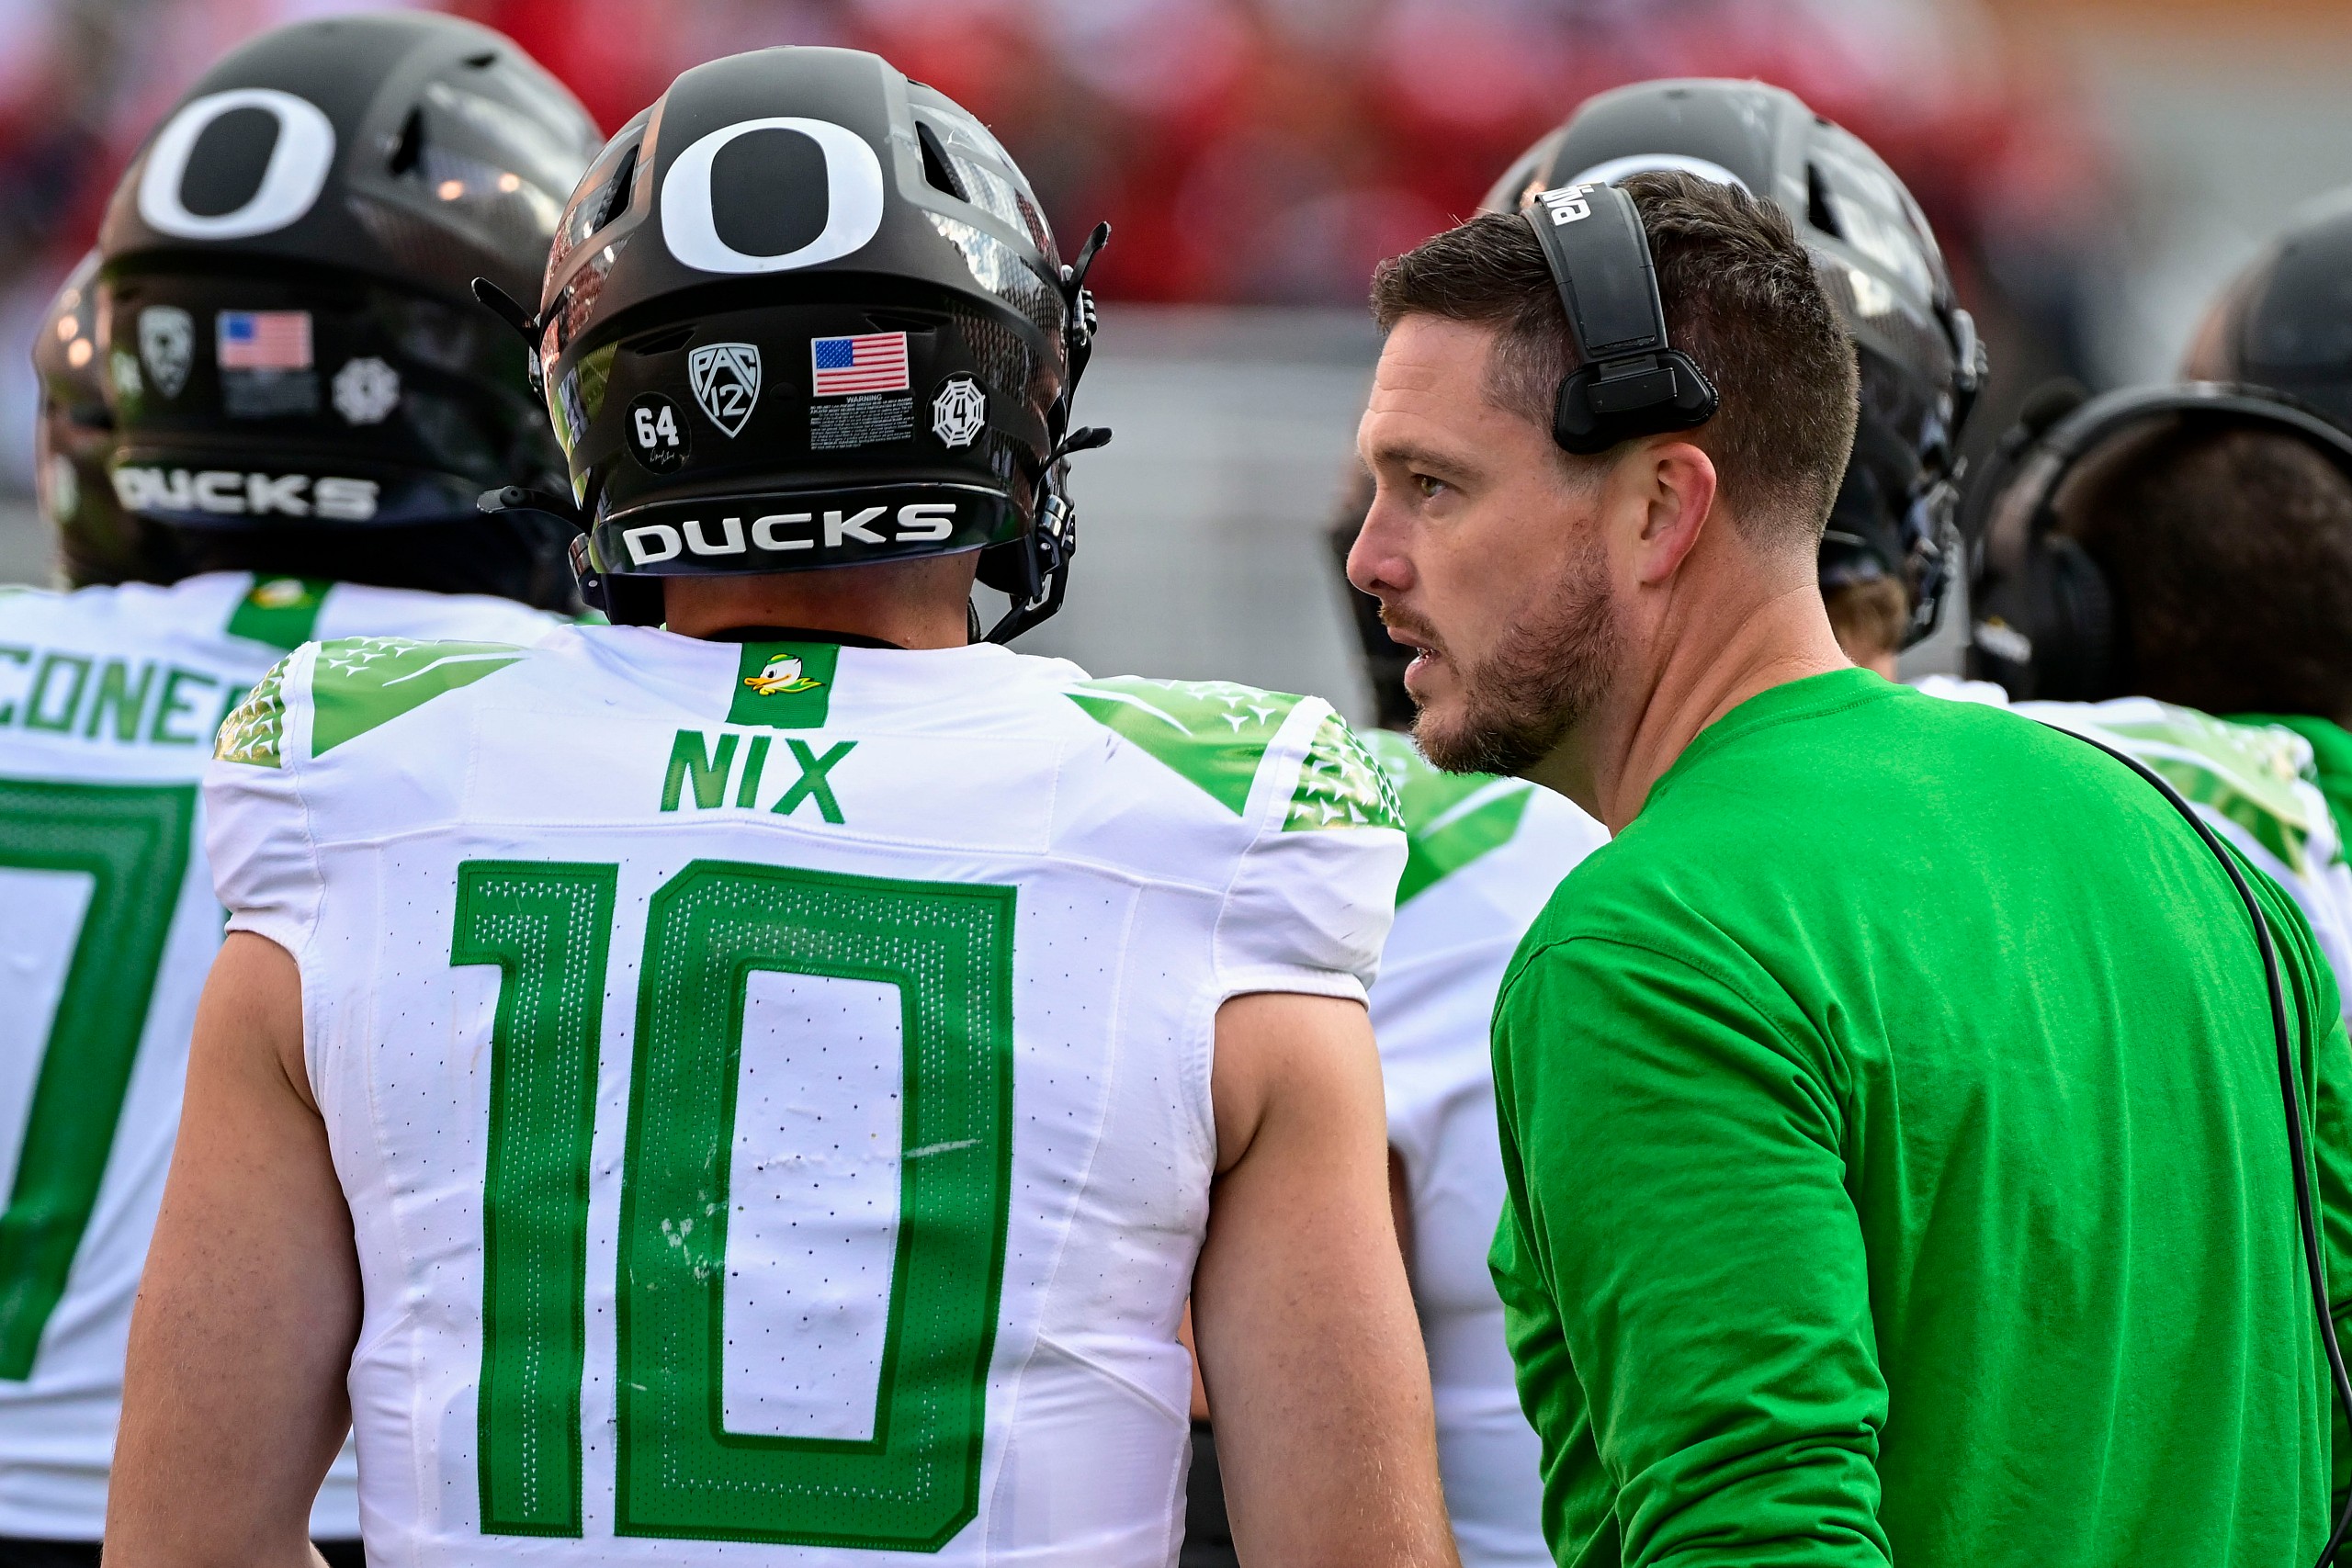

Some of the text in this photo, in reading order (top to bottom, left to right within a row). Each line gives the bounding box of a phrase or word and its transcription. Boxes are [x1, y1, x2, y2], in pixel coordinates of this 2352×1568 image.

[138, 87, 336, 240] O
[661, 117, 884, 274] O
[693, 347, 756, 402] PAC
[710, 383, 747, 417] 12
[846, 394, 882, 403] WARNING
[634, 405, 680, 448] 64
[111, 467, 379, 522] DUCKS
[623, 503, 956, 566] DUCKS
[660, 728, 859, 825] NIX
[450, 859, 1017, 1552] 10
